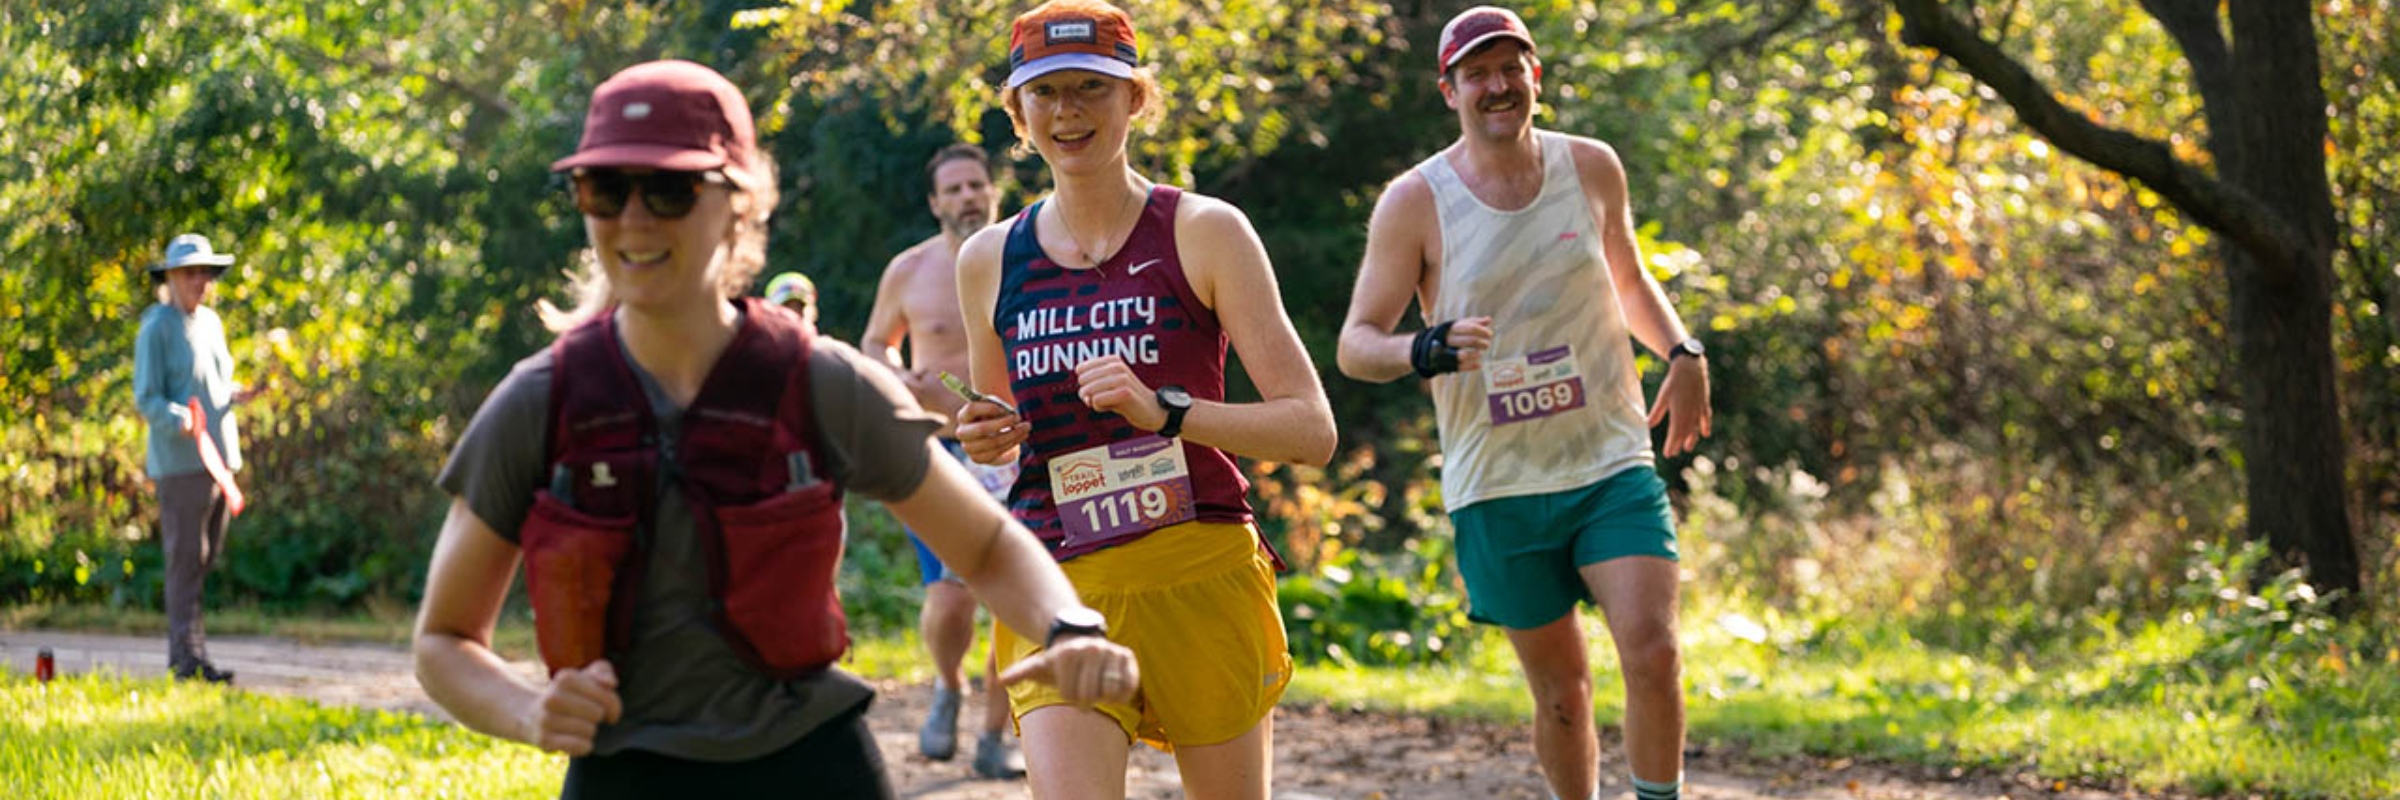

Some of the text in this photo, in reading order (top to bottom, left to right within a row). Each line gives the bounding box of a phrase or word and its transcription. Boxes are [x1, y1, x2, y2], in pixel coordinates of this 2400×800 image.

[1017, 296, 1156, 341] MILL CITY
[1016, 334, 1160, 380] RUNNING
[1500, 383, 1573, 418] 1069
[1062, 473, 1106, 496] loppet
[1081, 486, 1168, 533] 1119
